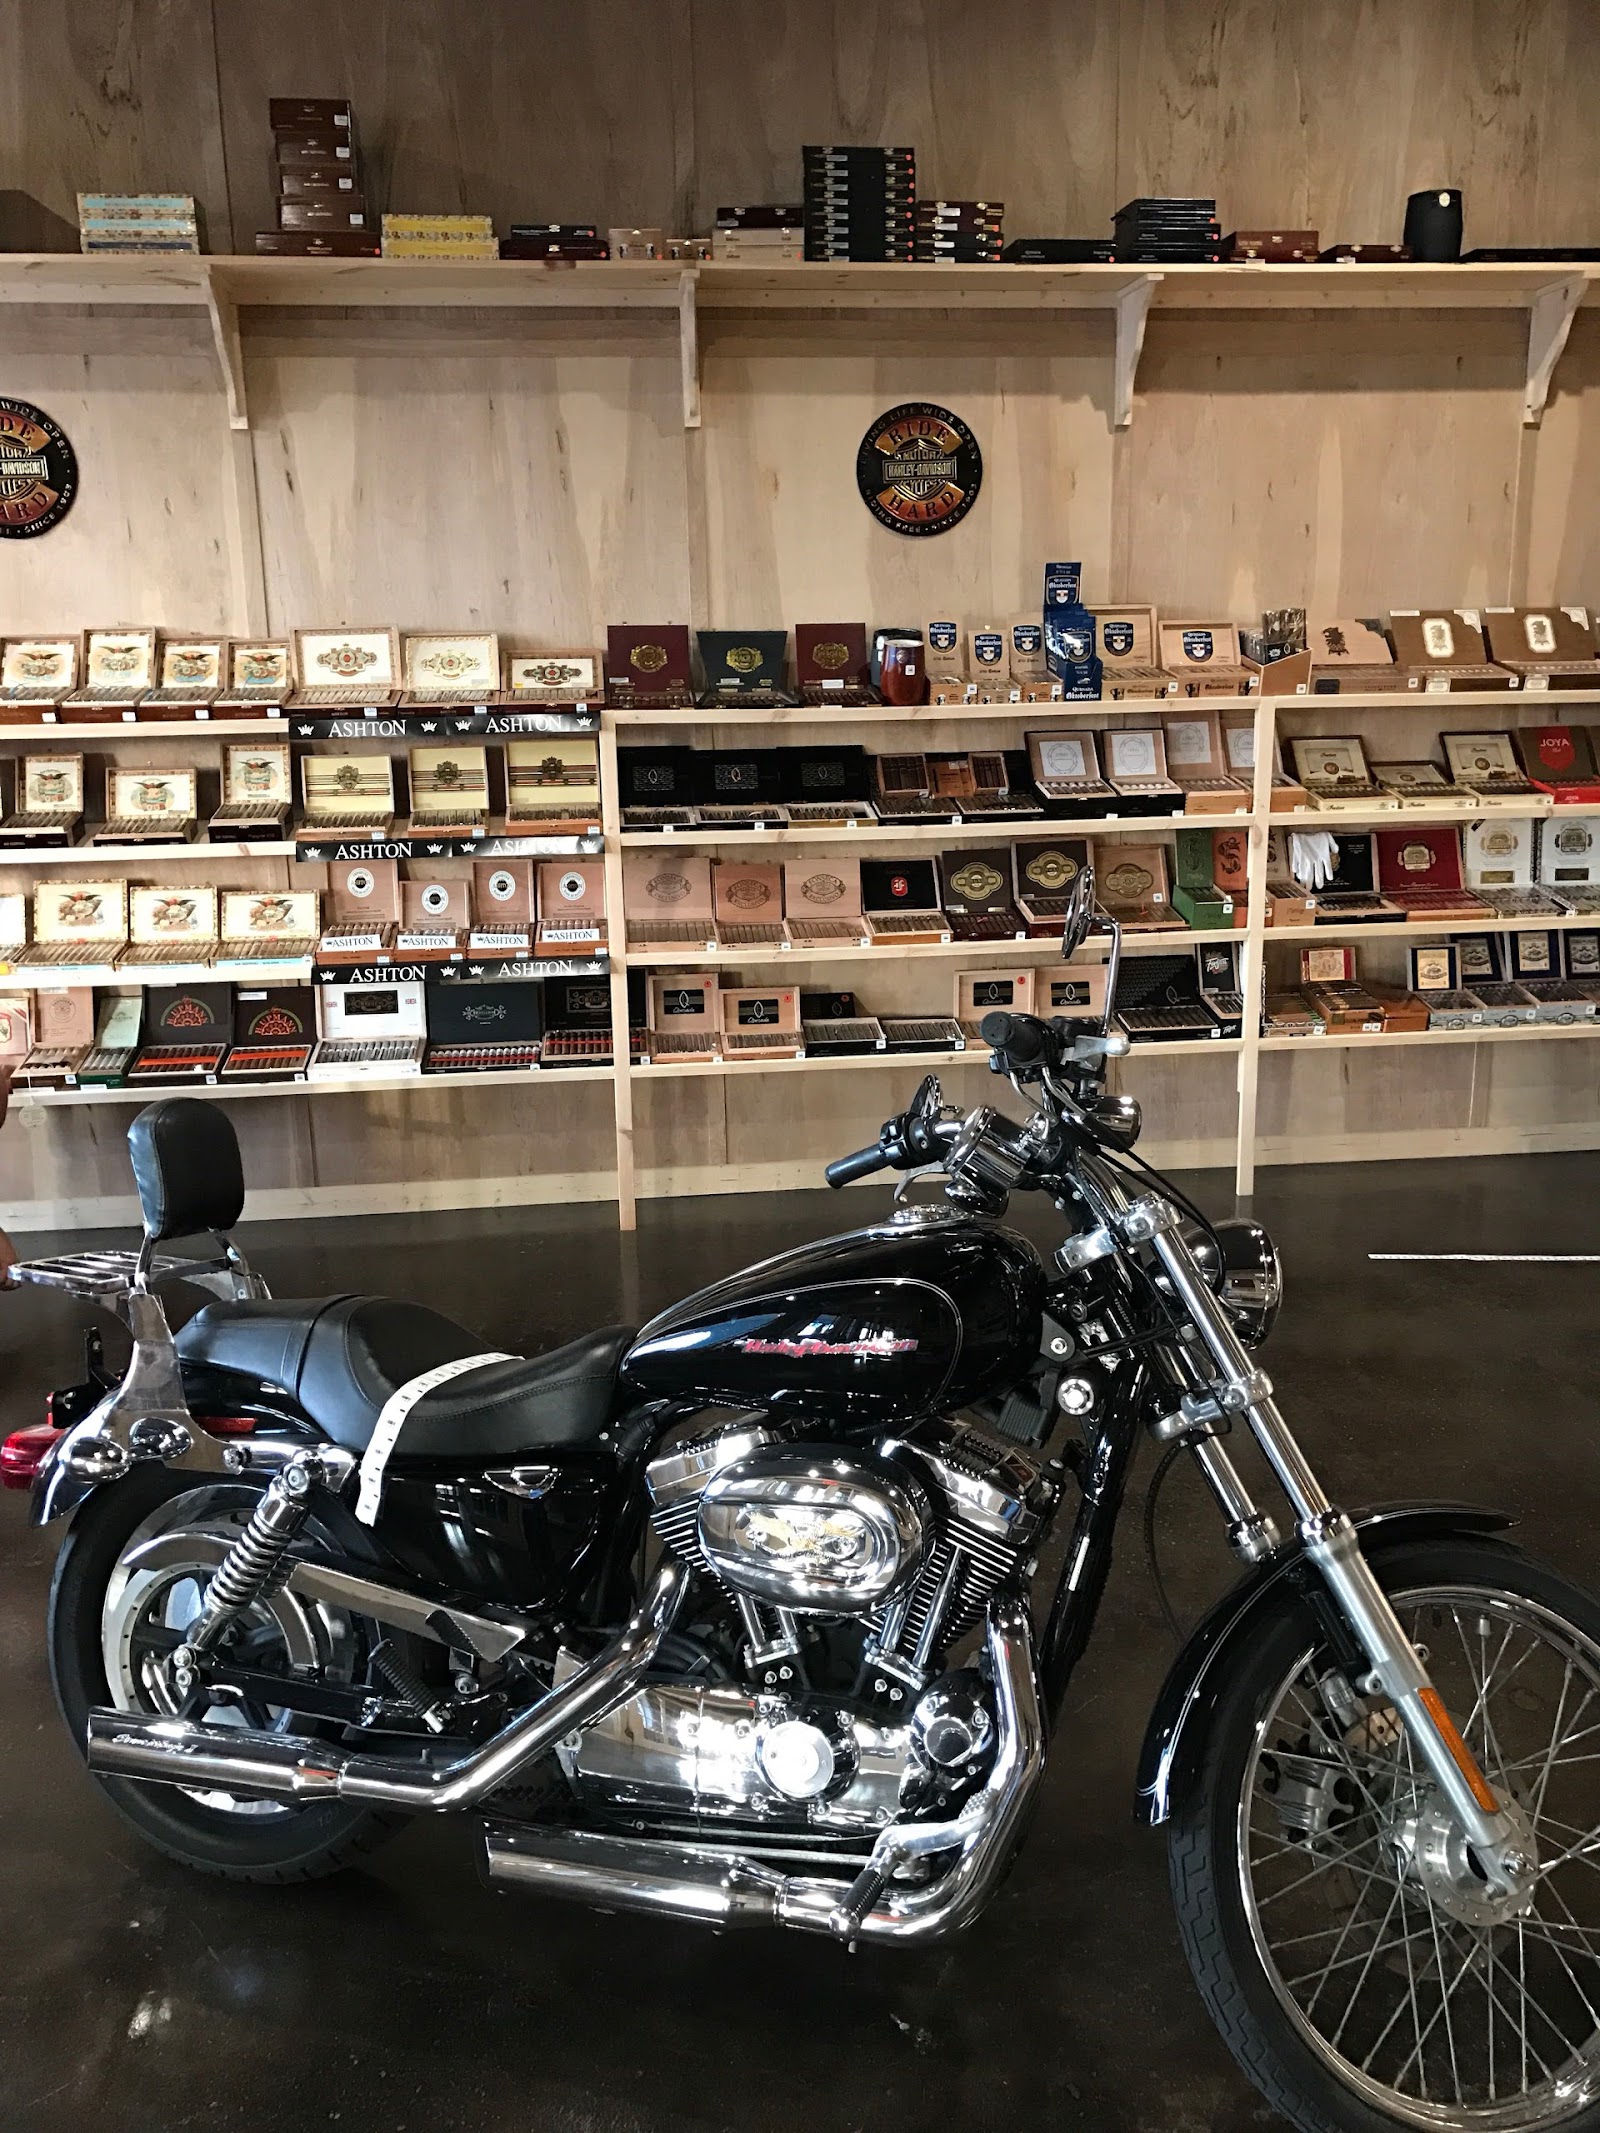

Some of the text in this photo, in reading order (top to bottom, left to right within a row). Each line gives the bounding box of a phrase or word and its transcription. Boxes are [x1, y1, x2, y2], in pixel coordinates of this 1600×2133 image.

[0, 401, 69, 459] WIDE OPEN
[2, 416, 36, 441] DE
[861, 406, 979, 464] LIVING LIFE WIDE OPEN
[887, 419, 951, 446] RIDE
[902, 447, 937, 460] MOTOR
[0, 461, 41, 476] -DAVIDSON
[888, 462, 952, 477] HARLEY-DAVIDSON
[903, 480, 939, 496] CYCLES
[0, 491, 50, 521] ARD
[24, 483, 73, 534] SINCE 1903
[864, 483, 978, 533] RIDING FREE SINCE 1903
[887, 490, 956, 519] HARD
[1065, 692, 1100, 700] Oktoberfest
[328, 719, 407, 738] ASHTON
[485, 715, 562, 734] ASHTON
[1540, 738, 1570, 747] JOYA
[334, 842, 414, 860] ASHTON
[490, 840, 564, 856] ASHO
[653, 873, 684, 884] FONSECA
[733, 880, 764, 890] FONSECA
[807, 874, 838, 885] FONSECA
[332, 936, 374, 948] ASHTON
[407, 937, 450, 946] ASHTON
[483, 935, 525, 945] ASHTON
[552, 930, 593, 941] ASHTON
[349, 965, 428, 983] ASHTON
[498, 959, 574, 977] ASHTON
[742, 1338, 919, 1358] Harley-Davidson
